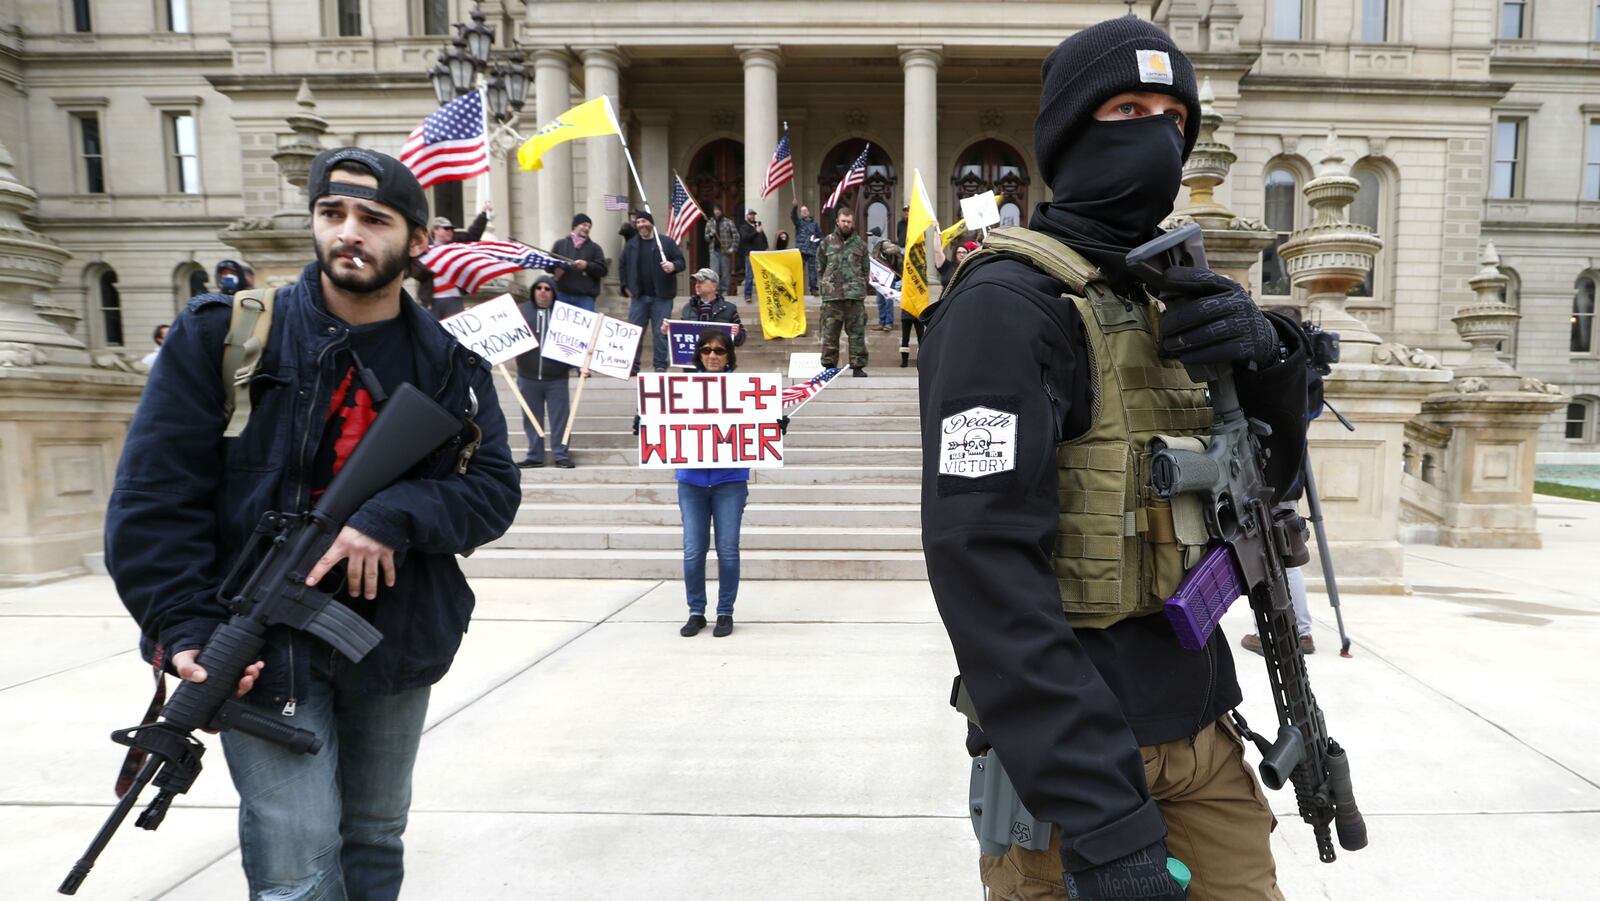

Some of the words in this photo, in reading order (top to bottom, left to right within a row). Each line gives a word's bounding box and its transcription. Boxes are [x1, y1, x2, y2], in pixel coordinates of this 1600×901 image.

[446, 313, 482, 337] ND
[555, 306, 593, 329] OPEN
[471, 324, 532, 357] CKDOWN
[604, 321, 638, 340] STOP
[638, 375, 743, 415] HEIL
[944, 413, 1013, 434] Death
[640, 422, 782, 464] WITMER
[944, 459, 1008, 472] VICTORY
